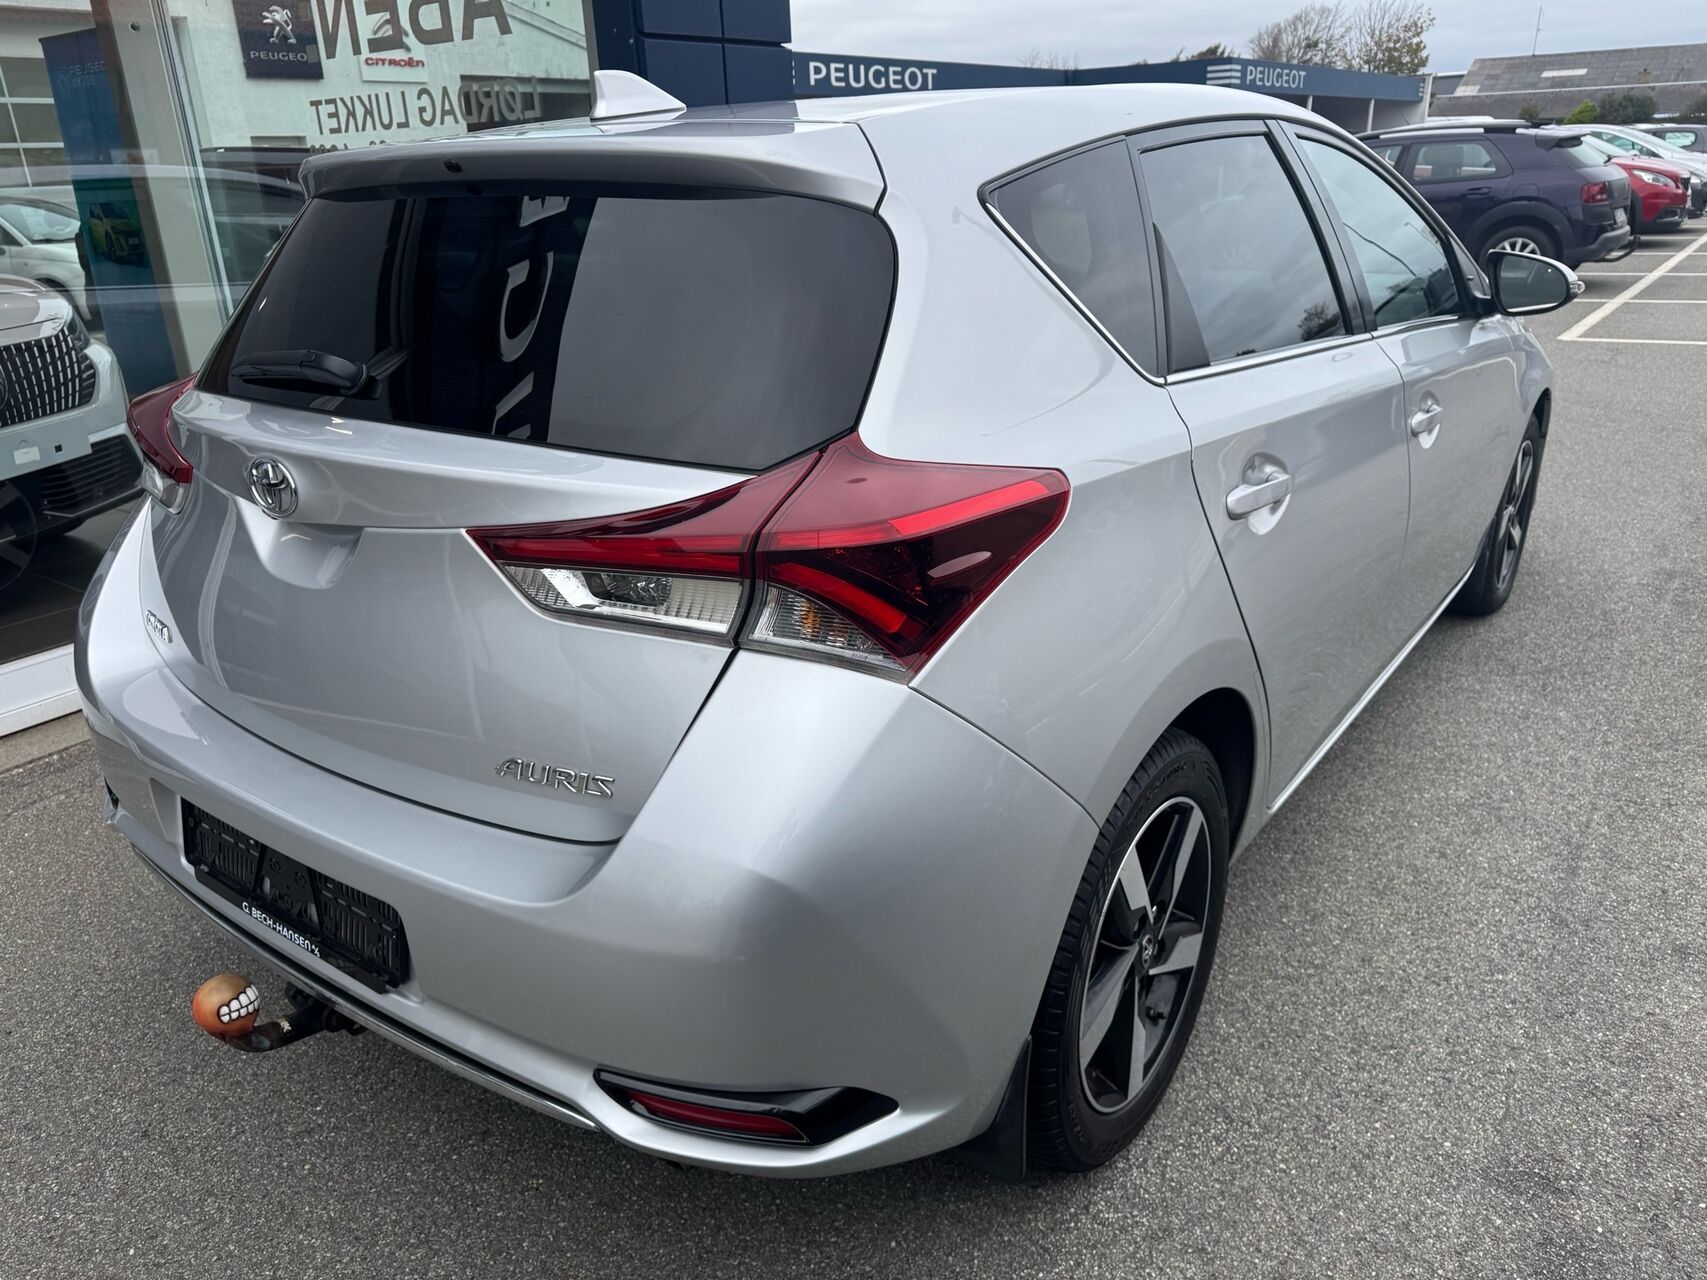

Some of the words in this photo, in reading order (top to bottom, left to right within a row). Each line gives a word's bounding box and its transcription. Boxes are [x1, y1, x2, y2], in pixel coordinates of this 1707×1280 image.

[808, 61, 937, 90] PEUGEOT
[1246, 65, 1306, 88] PEUGEOT
[496, 758, 615, 799] AURIS
